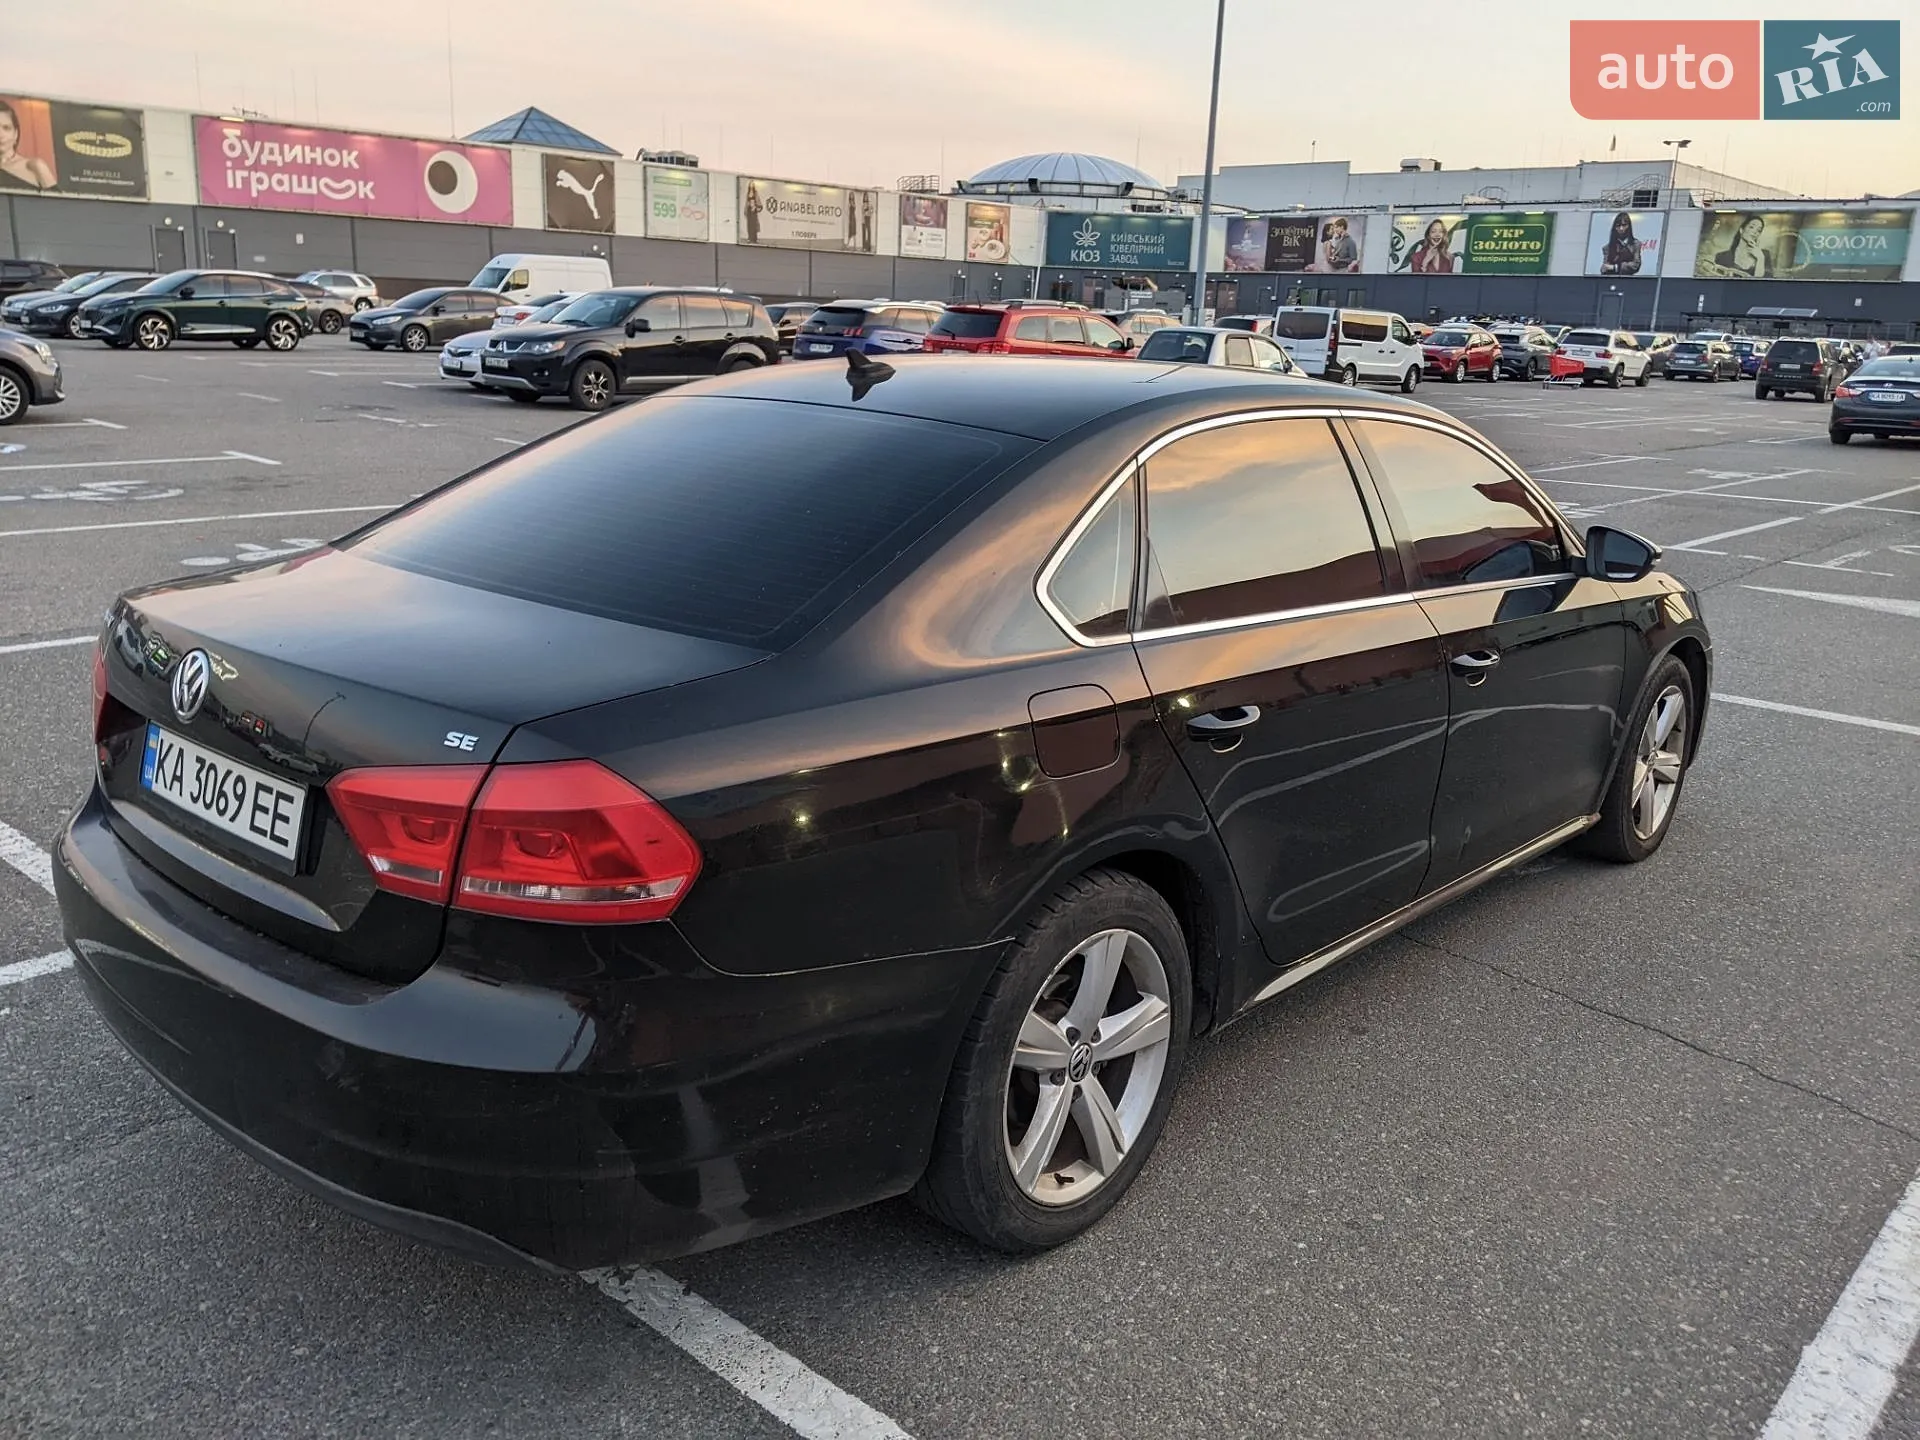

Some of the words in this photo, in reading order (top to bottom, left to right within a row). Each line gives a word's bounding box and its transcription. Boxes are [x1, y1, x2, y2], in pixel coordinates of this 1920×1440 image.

[222, 128, 360, 169] будинок
[653, 201, 677, 218] 599
[780, 201, 816, 216] ANABEL
[818, 206, 842, 218] ARTO
[1110, 233, 1165, 244] КИЇВСЬКИЙ
[1493, 229, 1524, 239] УКР
[1110, 244, 1164, 254] ЮВЕЛІРНИЙ
[1473, 240, 1541, 250] ЗОЛОТО
[1813, 235, 1888, 250] ЗОЛОТА
[1070, 249, 1100, 263] КЮЗ
[1109, 255, 1139, 265] ЗАВОД
[443, 731, 480, 751] SE
[155, 738, 184, 798] KA
[189, 755, 247, 823] 3069
[249, 781, 295, 848] EE
